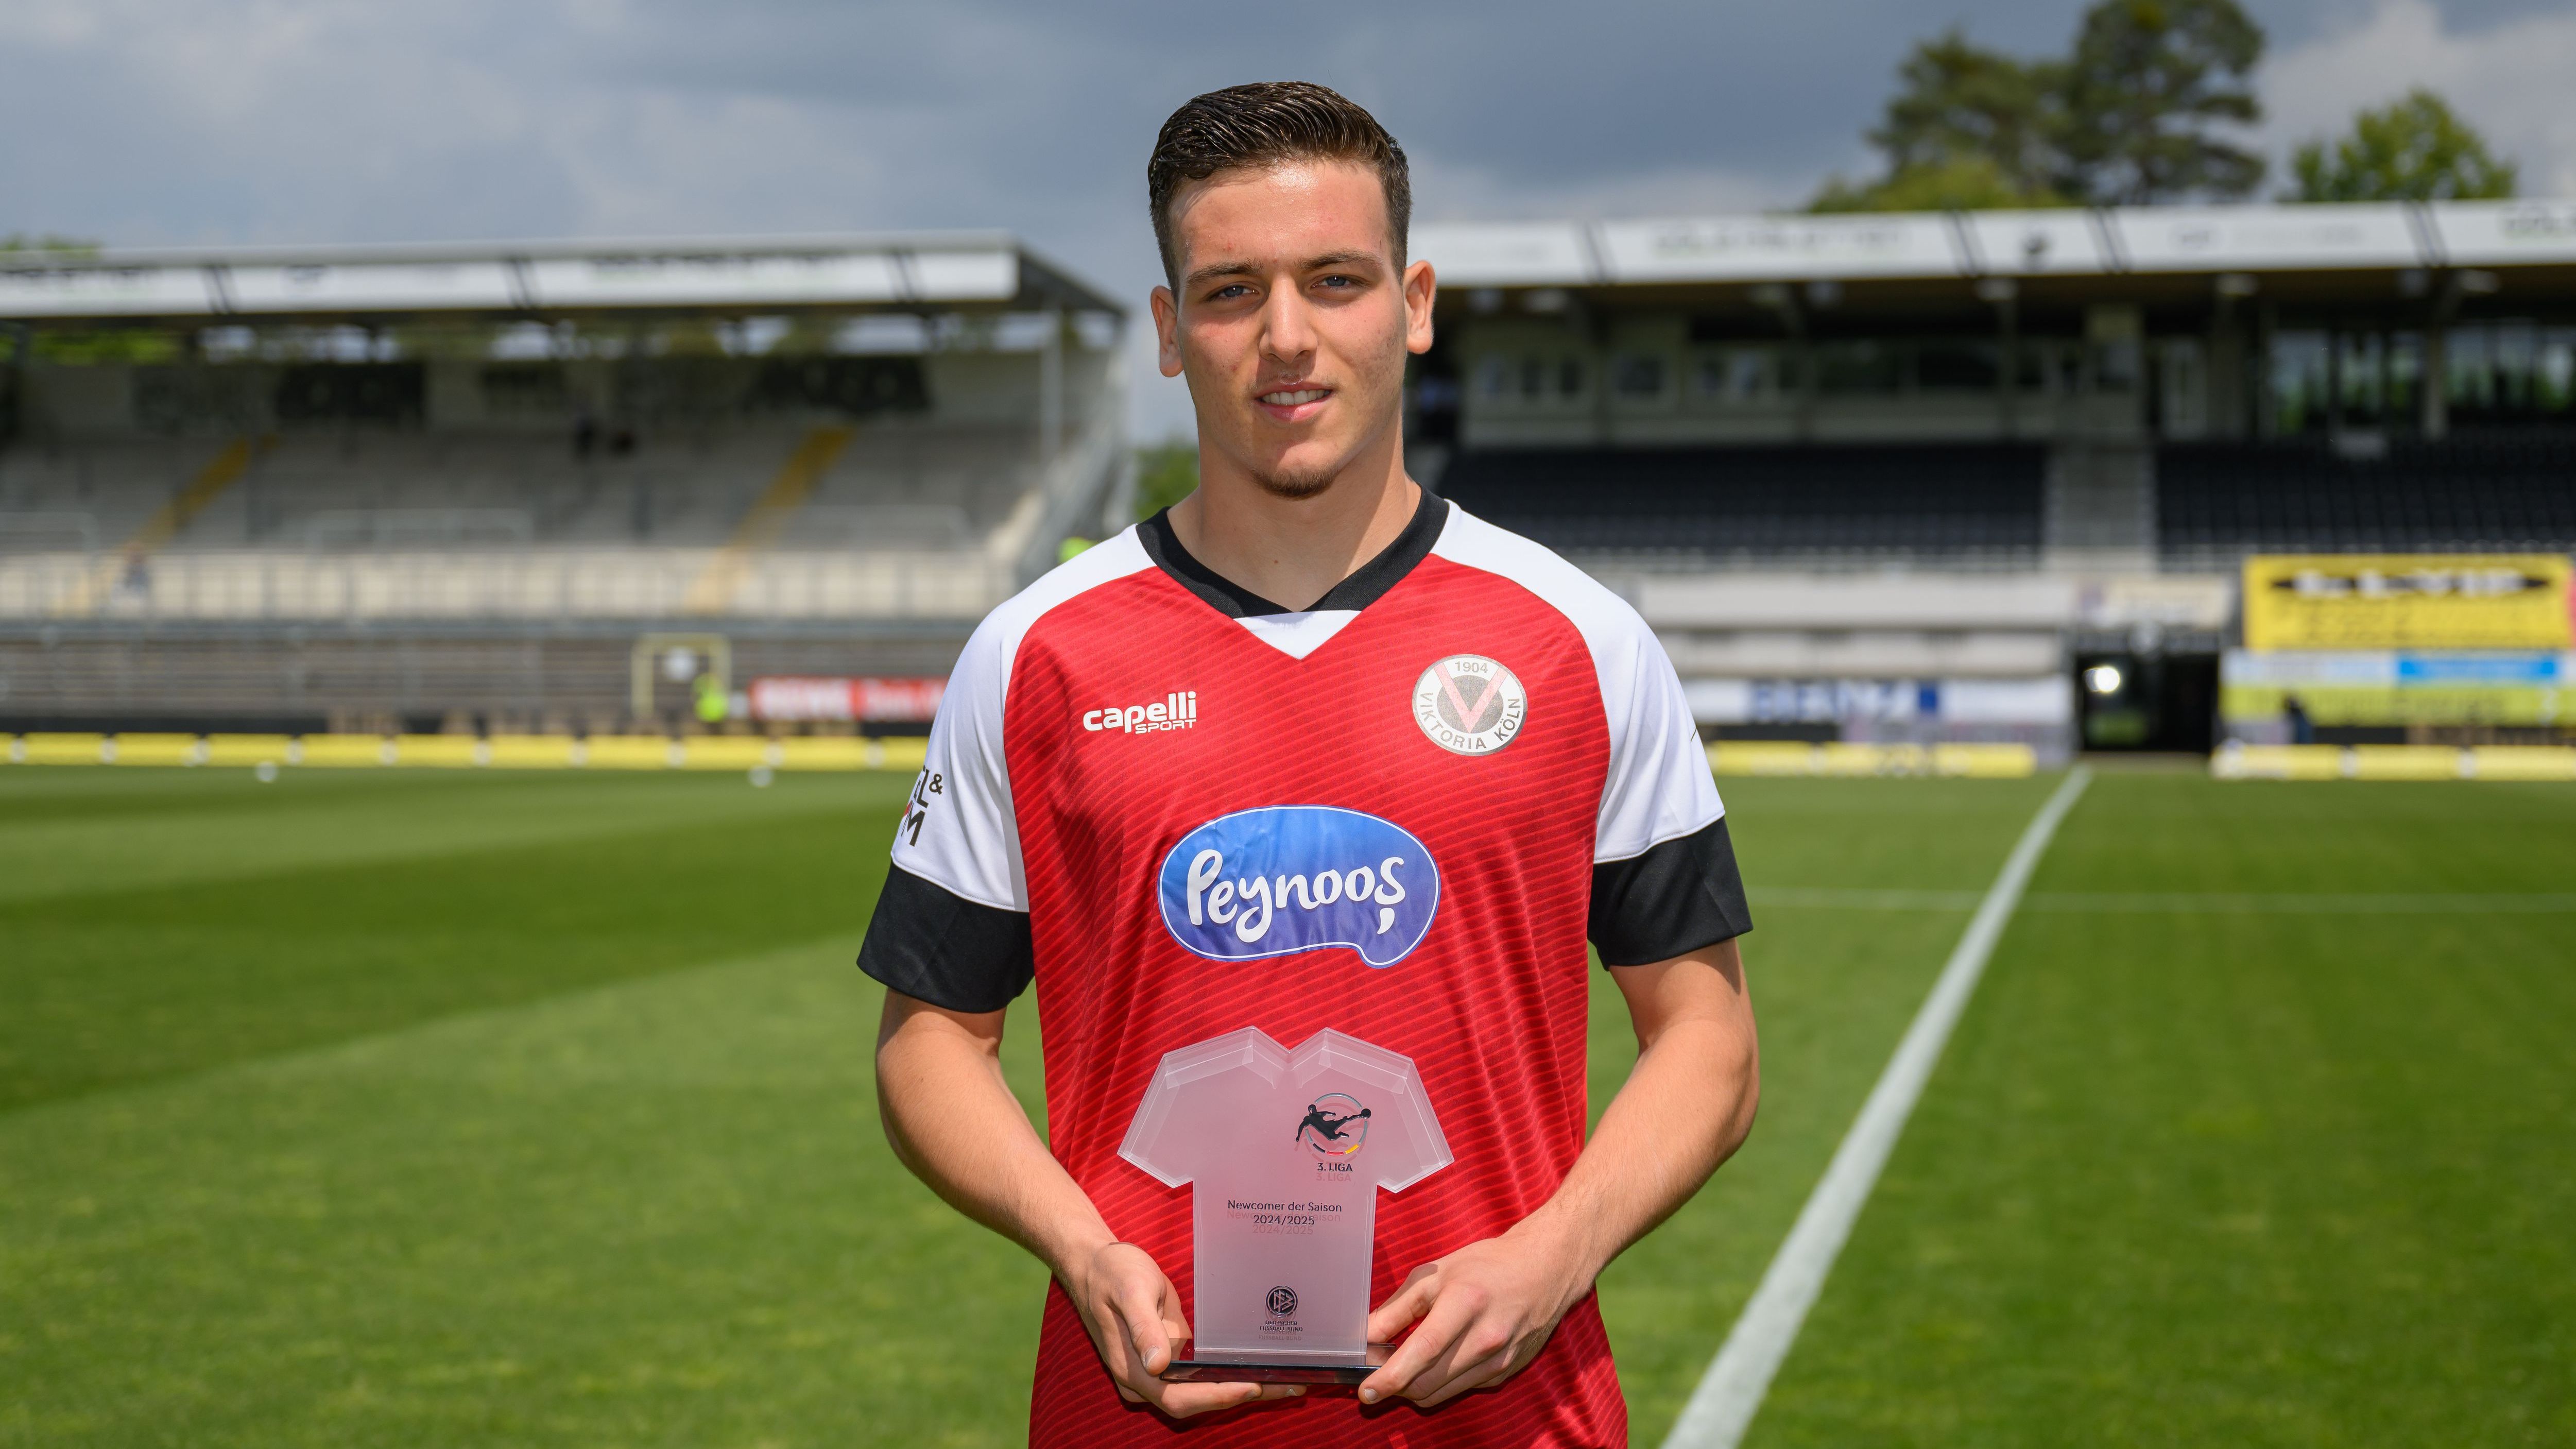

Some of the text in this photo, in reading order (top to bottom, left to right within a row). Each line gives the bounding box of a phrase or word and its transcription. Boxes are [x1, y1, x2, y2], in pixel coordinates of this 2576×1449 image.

[1455, 661, 1488, 673] 1904
[1083, 691, 1196, 734] capelli
[1135, 719, 1197, 734] SPORT
[1420, 692, 1521, 749] VIKTORIA KÖLN
[1317, 1163, 1353, 1172] 3. LIGA
[1228, 1200, 1342, 1212] Newcomer der Saison
[1253, 1215, 1315, 1225] 2024/2025
